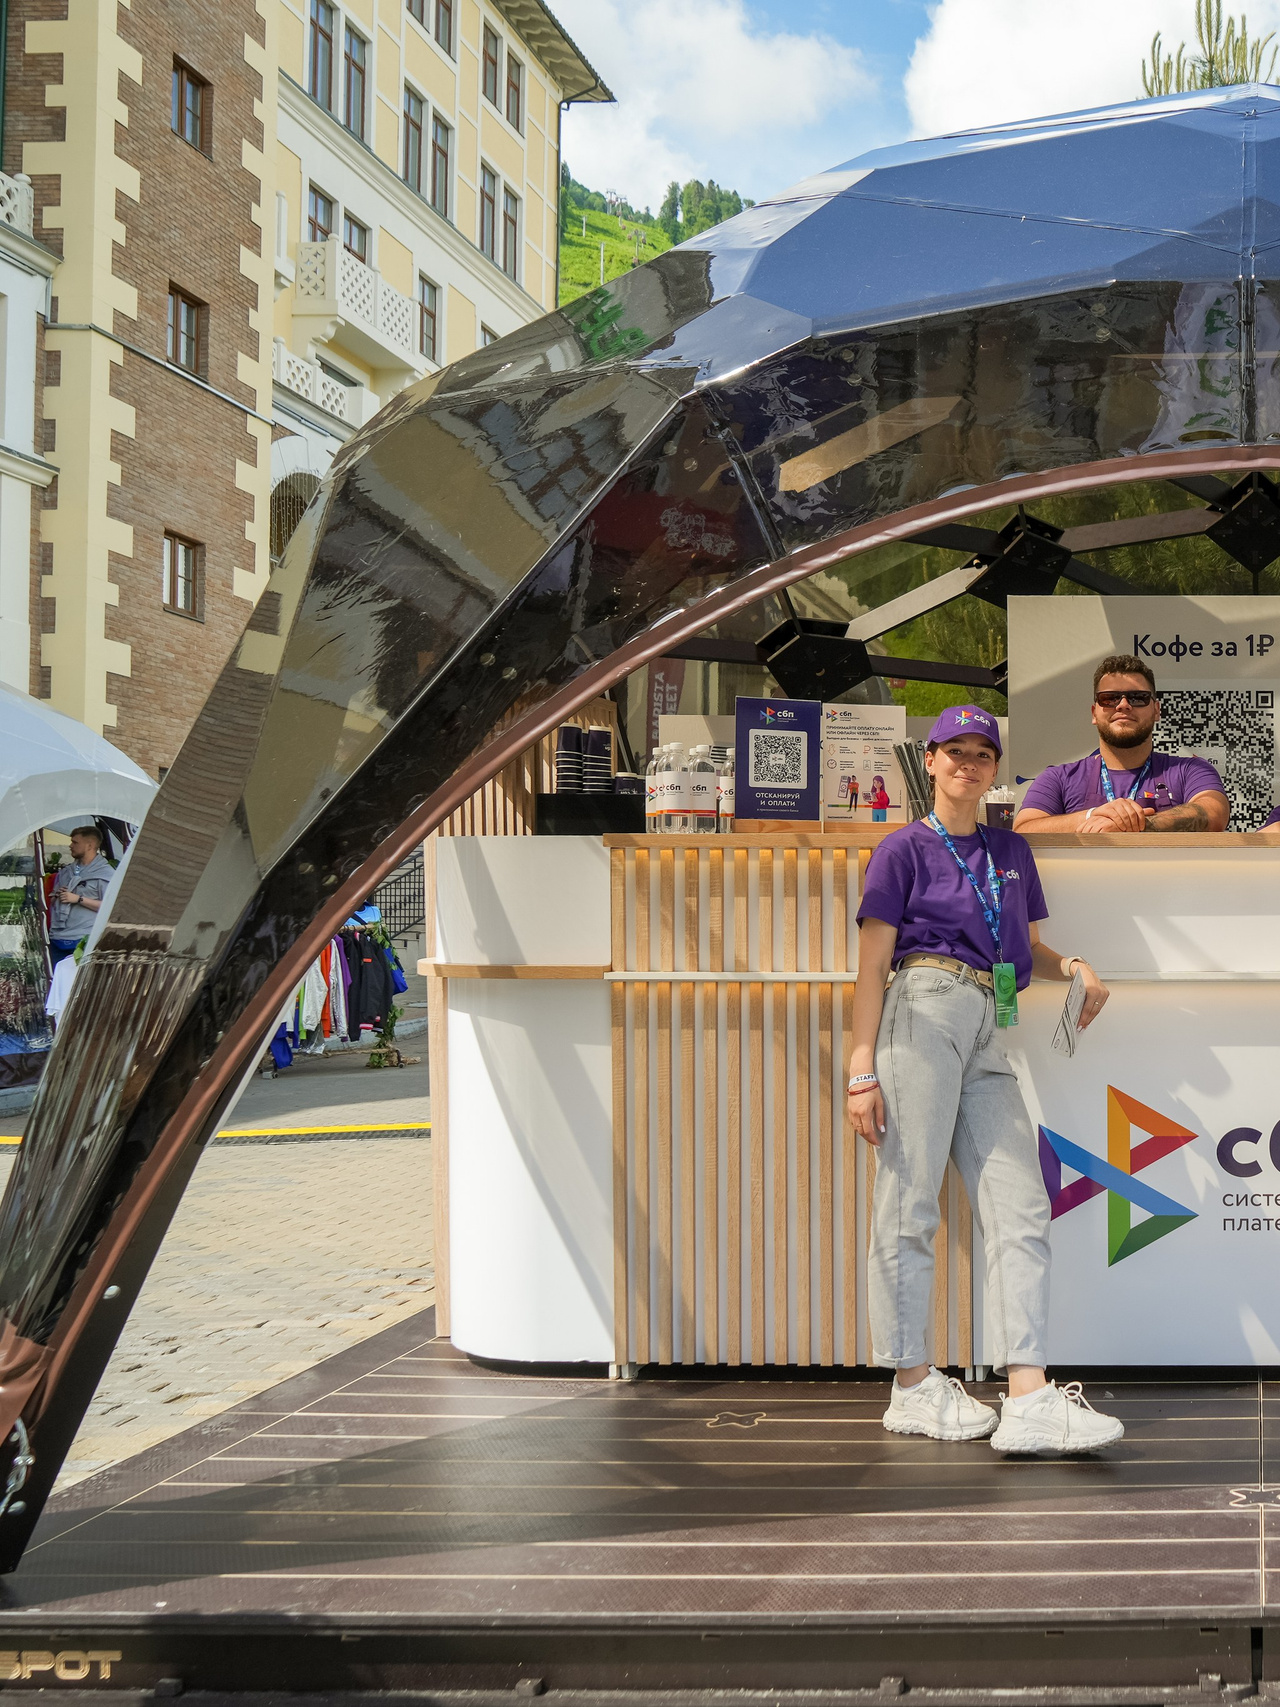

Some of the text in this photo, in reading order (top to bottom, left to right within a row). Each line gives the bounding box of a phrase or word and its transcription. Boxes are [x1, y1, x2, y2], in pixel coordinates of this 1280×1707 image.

[1133, 634, 1204, 662] Кофе
[1211, 641, 1238, 657] за
[777, 710, 794, 718] сбп
[973, 714, 991, 727] сбп
[1207, 757, 1218, 765] бп
[755, 792, 800, 800] ОТСКАНИРУЙ
